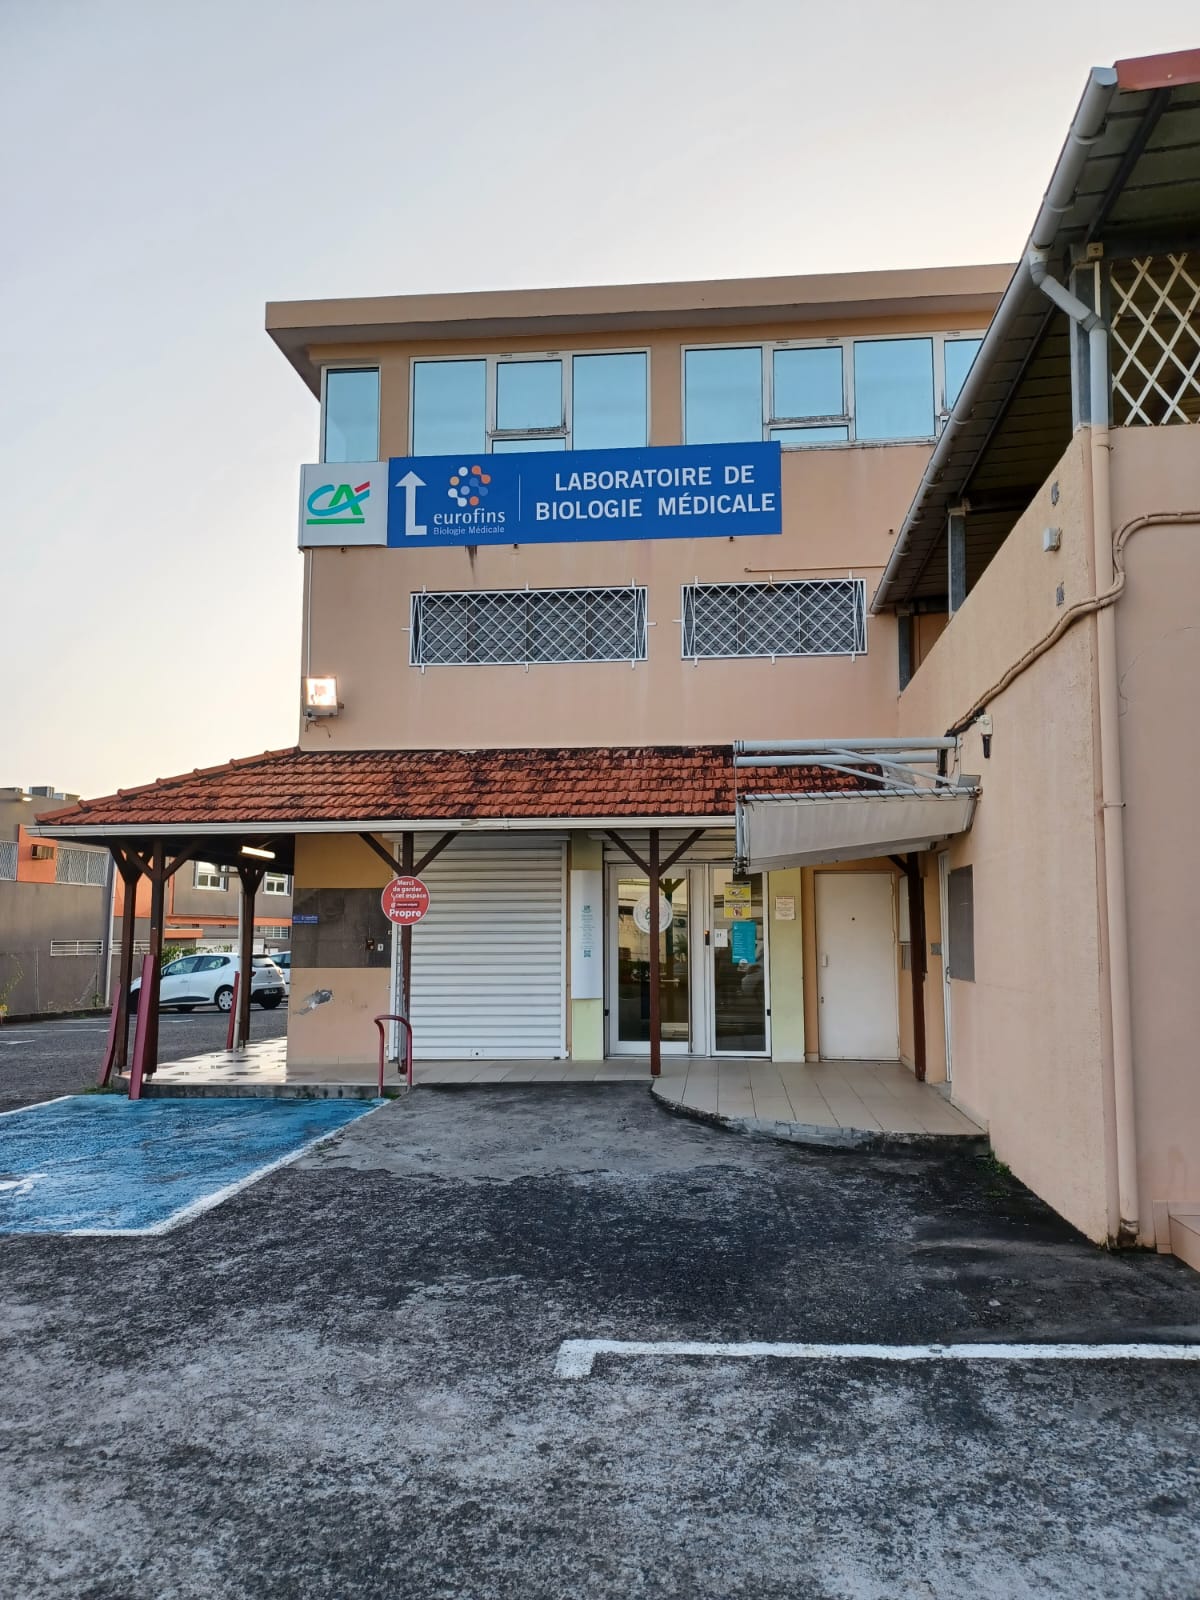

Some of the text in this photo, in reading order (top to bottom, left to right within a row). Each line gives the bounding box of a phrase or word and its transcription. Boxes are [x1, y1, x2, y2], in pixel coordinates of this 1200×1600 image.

[555, 465, 755, 492] LABORATOIRE DE
[307, 481, 371, 517] CA
[536, 492, 776, 521] BIOLOGIE MÉDICALE
[433, 508, 506, 525] eurofins
[433, 525, 505, 536] Biologie Médicale
[401, 886, 422, 894] garder
[389, 908, 421, 919] Propre
